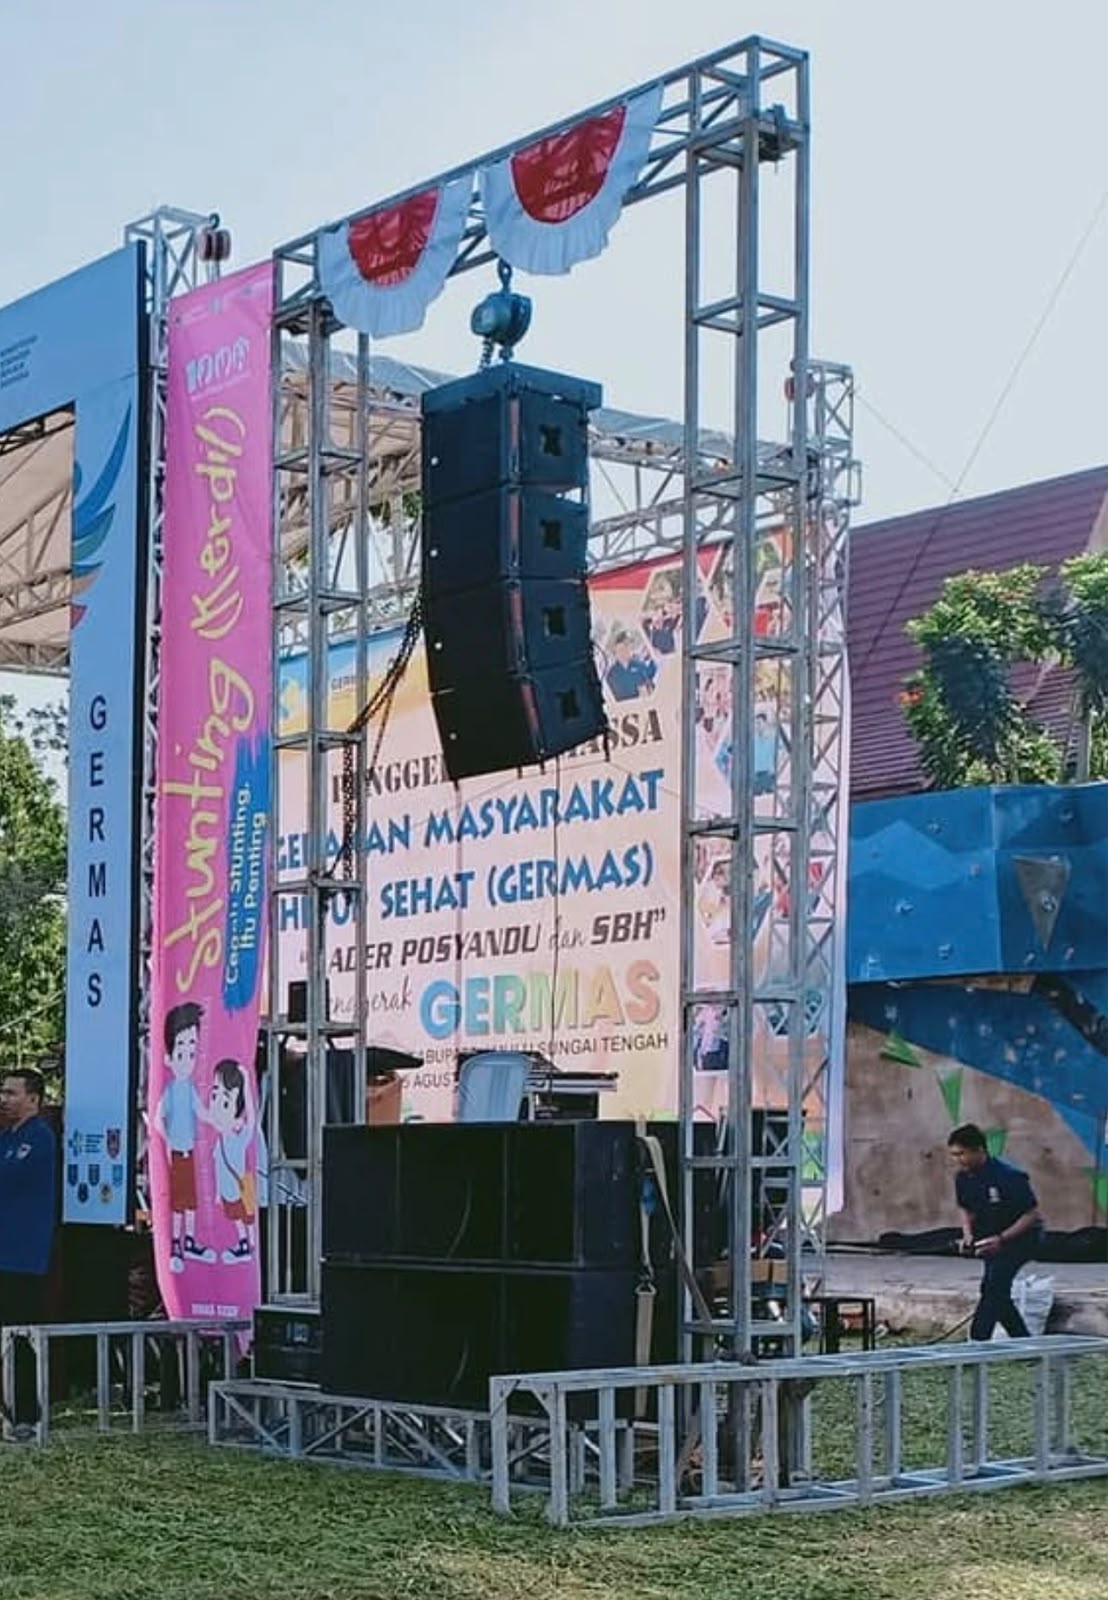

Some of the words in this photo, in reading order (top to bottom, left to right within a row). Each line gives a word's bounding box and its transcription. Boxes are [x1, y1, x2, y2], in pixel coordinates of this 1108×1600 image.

[163, 658, 255, 992] Stunting
[424, 768, 665, 848] MASYARAKAT
[87, 694, 107, 1007] GERMAS
[381, 871, 475, 919] SEHAT
[488, 846, 653, 908] (GERMAS)
[401, 920, 541, 966] POSYANDU
[420, 958, 661, 1040] GERMAS
[601, 1032, 668, 1053] TENGAH
